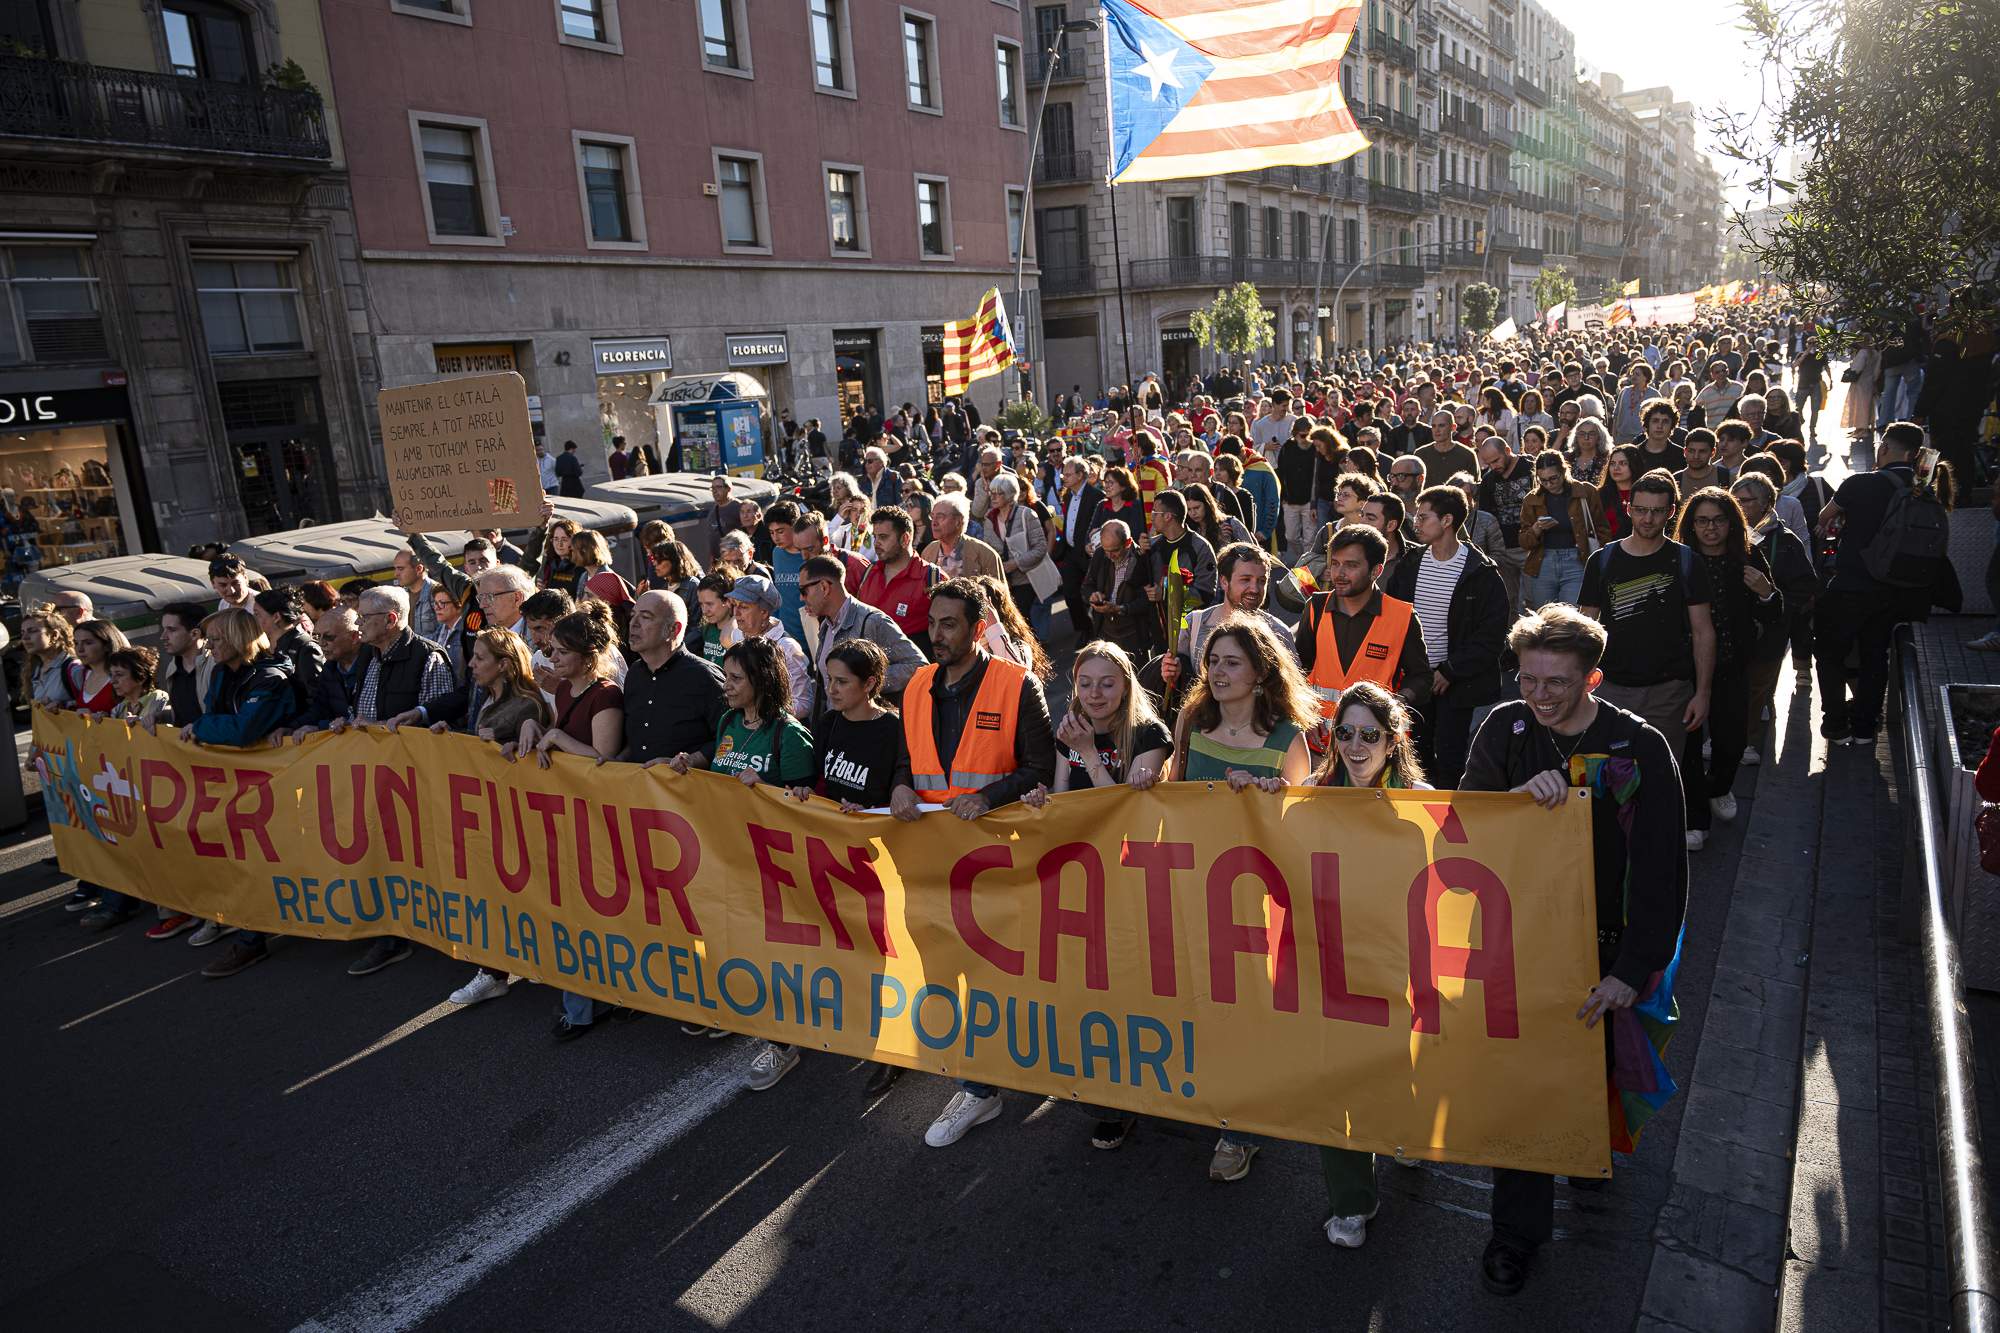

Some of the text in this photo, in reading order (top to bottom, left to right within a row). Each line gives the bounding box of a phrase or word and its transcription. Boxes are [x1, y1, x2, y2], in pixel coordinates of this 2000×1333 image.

[554, 351, 571, 366] 42
[602, 350, 666, 363] FLORENCIA
[732, 344, 784, 356] FLORENCIA
[466, 354, 512, 371] D'OFICINES
[385, 384, 502, 416] MANTENIR EL CATALÀ
[432, 421, 440, 436] A
[442, 417, 463, 433] TOT
[468, 411, 504, 430] ARREU
[403, 447, 423, 462] AMB
[428, 441, 468, 459] TOTHOM
[476, 431, 506, 454] FARÀ
[396, 459, 496, 482] AUGMENTAR EL SEU
[400, 484, 414, 501] ÚS
[750, 753, 773, 772] SÍ
[829, 758, 869, 786] FORJA
[140, 759, 1519, 1039] PER UN FUTUR EN CATALÀ
[272, 875, 1195, 1098] RECUPEREM LA BARCELONA POPULAR!
